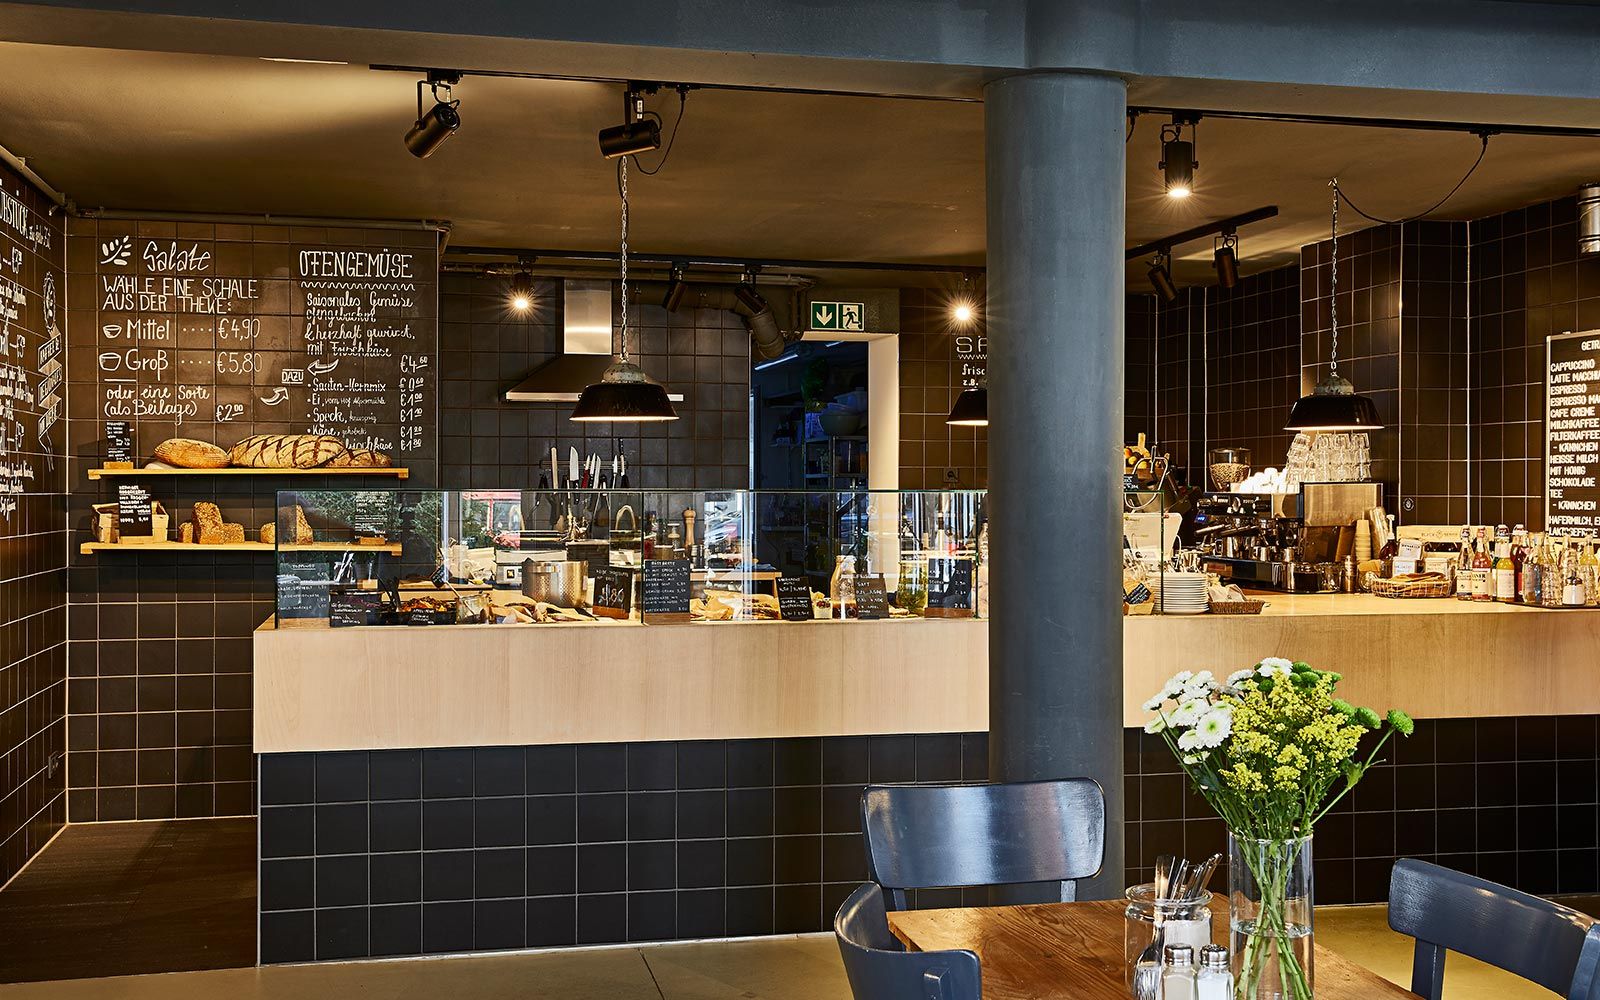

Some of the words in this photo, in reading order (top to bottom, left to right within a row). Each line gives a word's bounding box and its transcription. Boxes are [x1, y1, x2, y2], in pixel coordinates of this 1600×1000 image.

[142, 240, 210, 272] Salate
[300, 248, 413, 278] OFENGEMÜSE
[102, 276, 156, 294] WÄHLE
[162, 278, 194, 297] EINE
[202, 278, 258, 299] SCHALE
[102, 294, 134, 311] AUS
[140, 295, 167, 312] DER
[307, 291, 361, 307] Saisonales
[126, 319, 169, 340] Mittel
[218, 318, 261, 341] €4,90
[307, 342, 324, 355] mit
[1581, 340, 1600, 351] GETR
[125, 349, 168, 381] Groß
[216, 352, 263, 375] €5,80
[1550, 359, 1595, 372] CAPPUCCINO
[282, 372, 304, 381] DAZU
[106, 385, 135, 400] oder
[140, 387, 171, 399] eine
[178, 385, 210, 400] Sorte
[1550, 384, 1587, 395] ESPRESSO
[1550, 395, 1587, 406] ESPRESSO
[104, 401, 130, 417] (als
[133, 400, 197, 426] Beilage)
[1550, 418, 1600, 429] MILCHKAFFEE
[1550, 431, 1600, 441] FILTERKAFFEE
[1550, 454, 1575, 464] HEISSE
[1576, 454, 1598, 464] MILCH
[1550, 466, 1562, 475] MIT
[1564, 466, 1586, 475] HONIG
[1549, 478, 1595, 487] SCHOKOLADE
[1549, 489, 1563, 498] TEE
[1549, 516, 1593, 526] HAFERMILCH,
